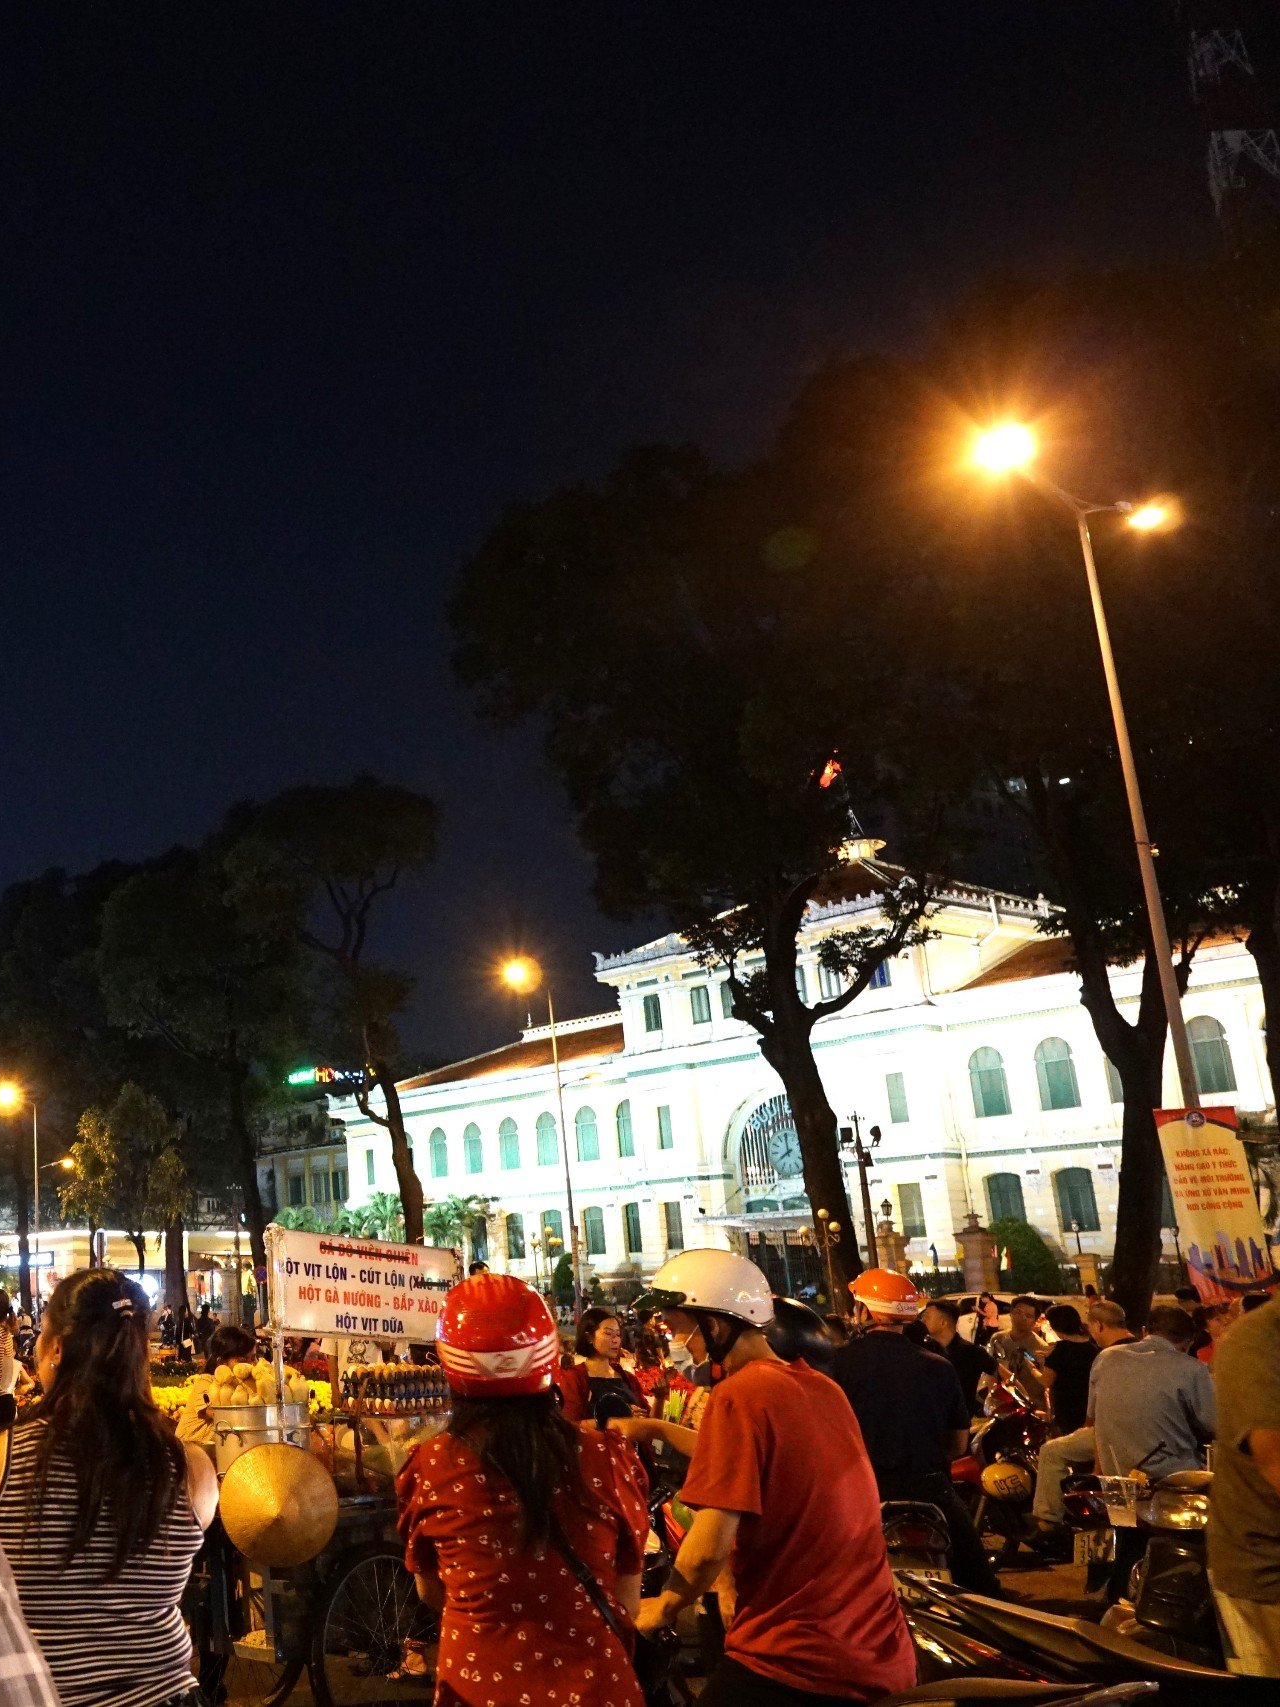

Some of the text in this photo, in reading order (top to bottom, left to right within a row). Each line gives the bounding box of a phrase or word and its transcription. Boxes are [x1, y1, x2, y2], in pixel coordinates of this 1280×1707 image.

[284, 1257, 301, 1277] ỘT
[303, 1262, 322, 1280] VỊT
[326, 1262, 347, 1282] LỘN
[359, 1267, 381, 1285] CÚT
[384, 1269, 405, 1289] LỘN
[298, 1283, 322, 1304] HỘT
[325, 1286, 340, 1305] GÀ
[343, 1287, 381, 1309] NƯỚNG
[393, 1292, 415, 1311] BẮP
[417, 1297, 438, 1314] XÀO
[335, 1312, 358, 1332] HỘT
[361, 1317, 379, 1335] VỊT
